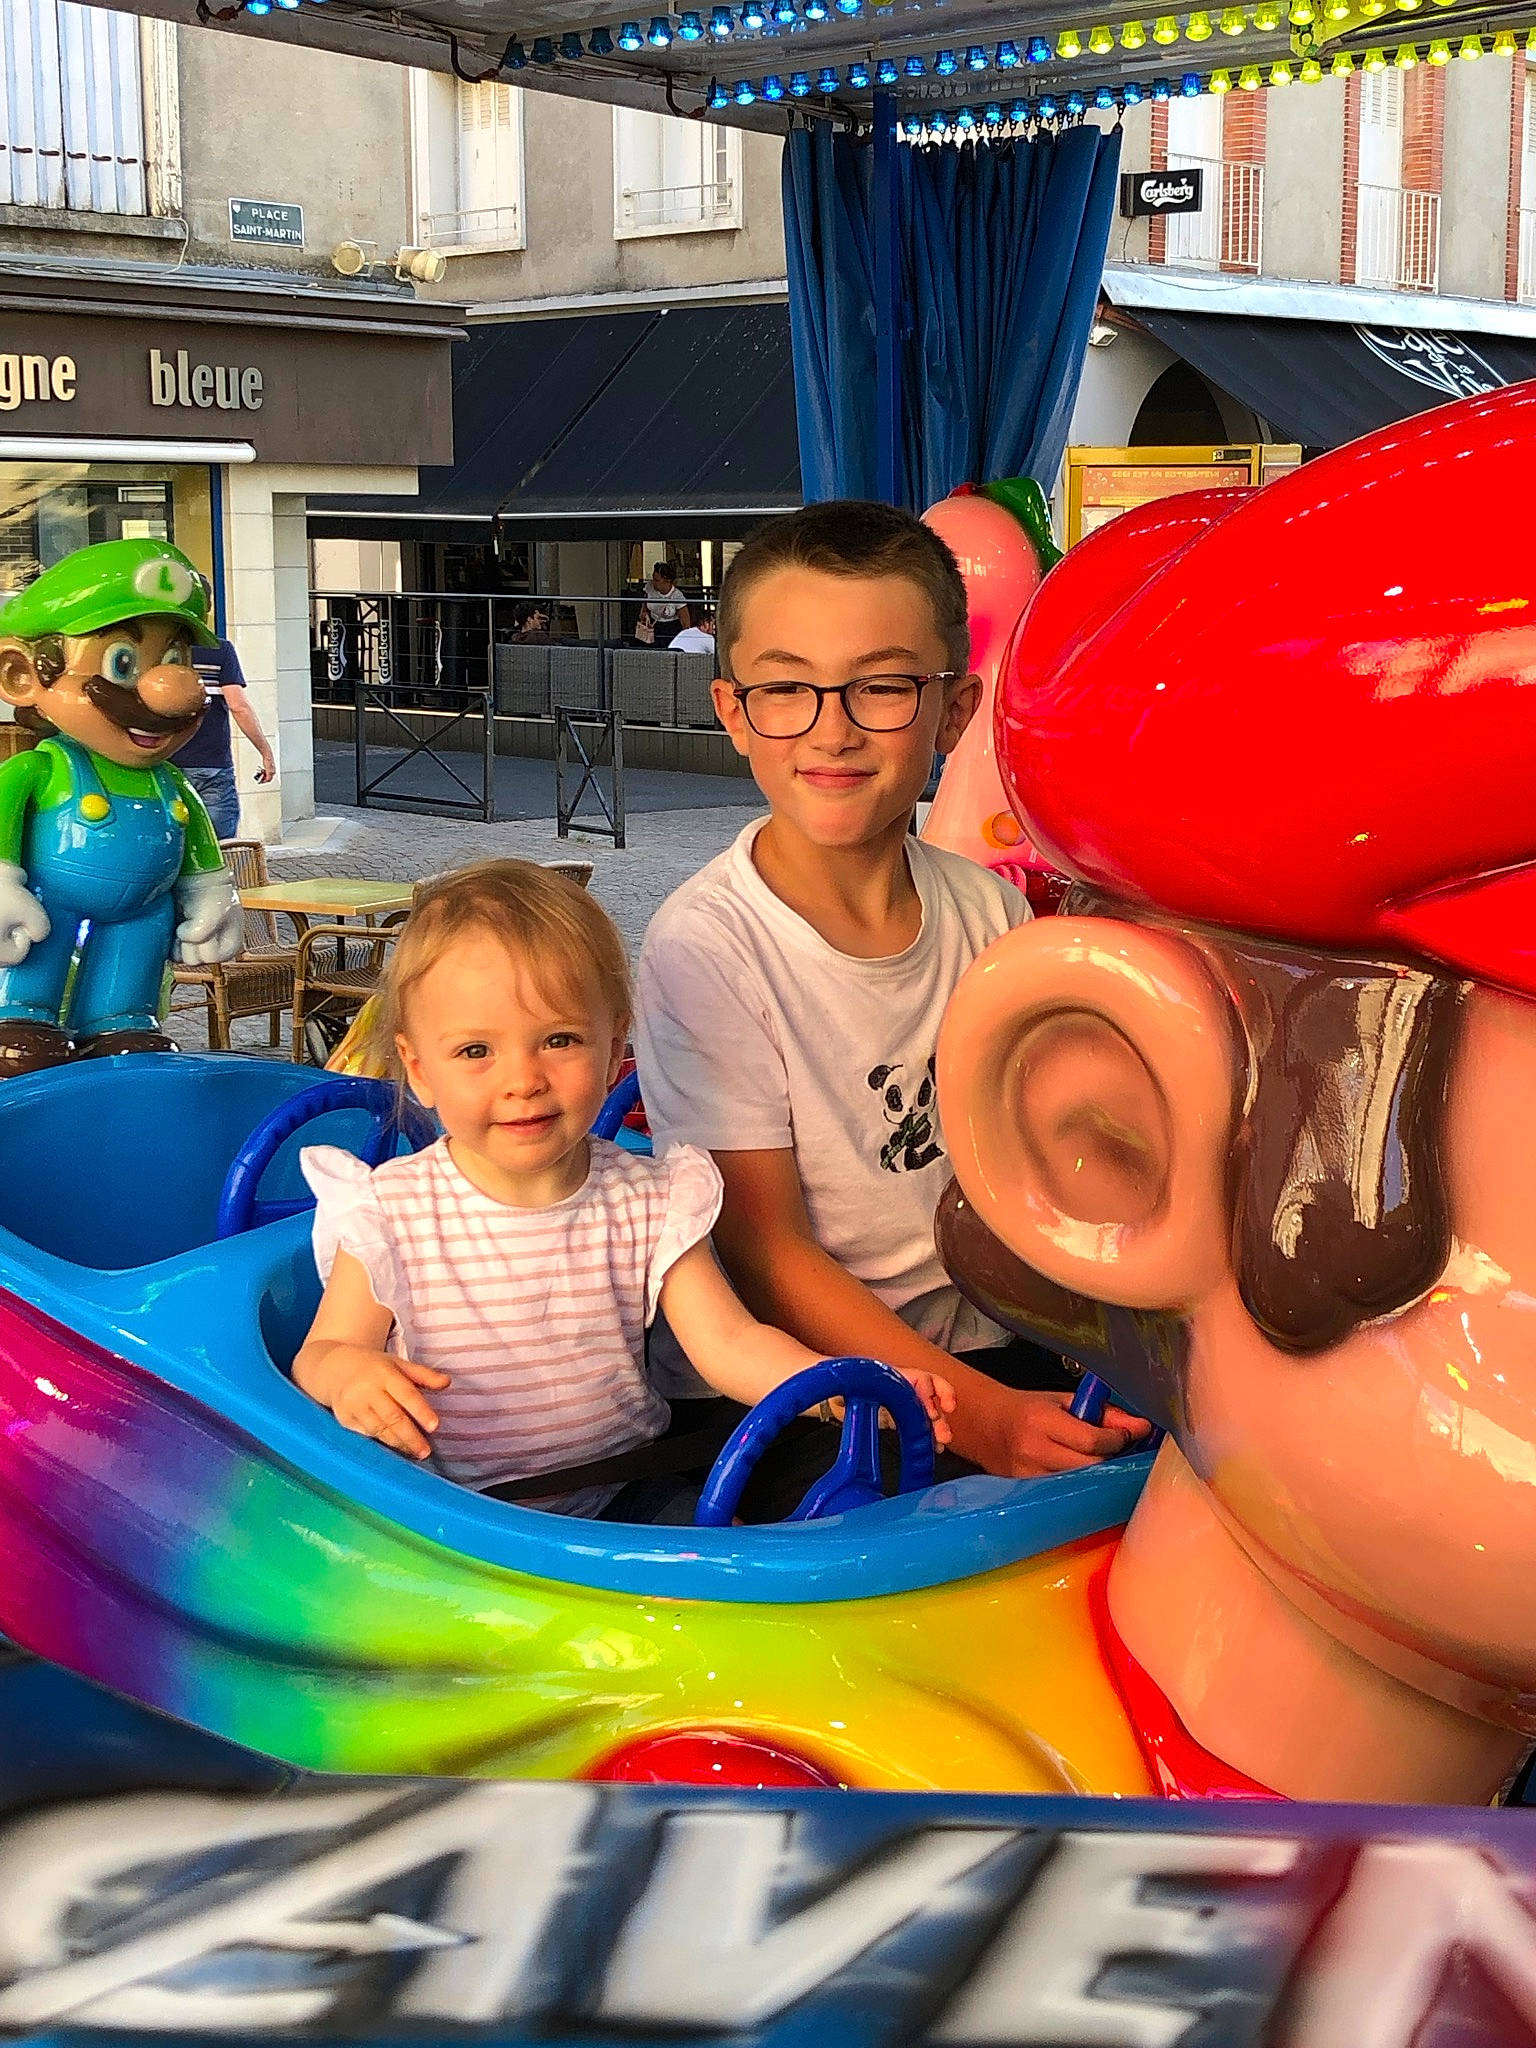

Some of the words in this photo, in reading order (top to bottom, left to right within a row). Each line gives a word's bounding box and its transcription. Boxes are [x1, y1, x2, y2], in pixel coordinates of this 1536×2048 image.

[1140, 178, 1194, 205] Carlsberg
[251, 207, 289, 221] PLACE
[233, 224, 302, 240] SAINT-MARTIN
[150, 349, 263, 411] bleue
[159, 565, 174, 592] L
[328, 617, 346, 680] Carlsberg
